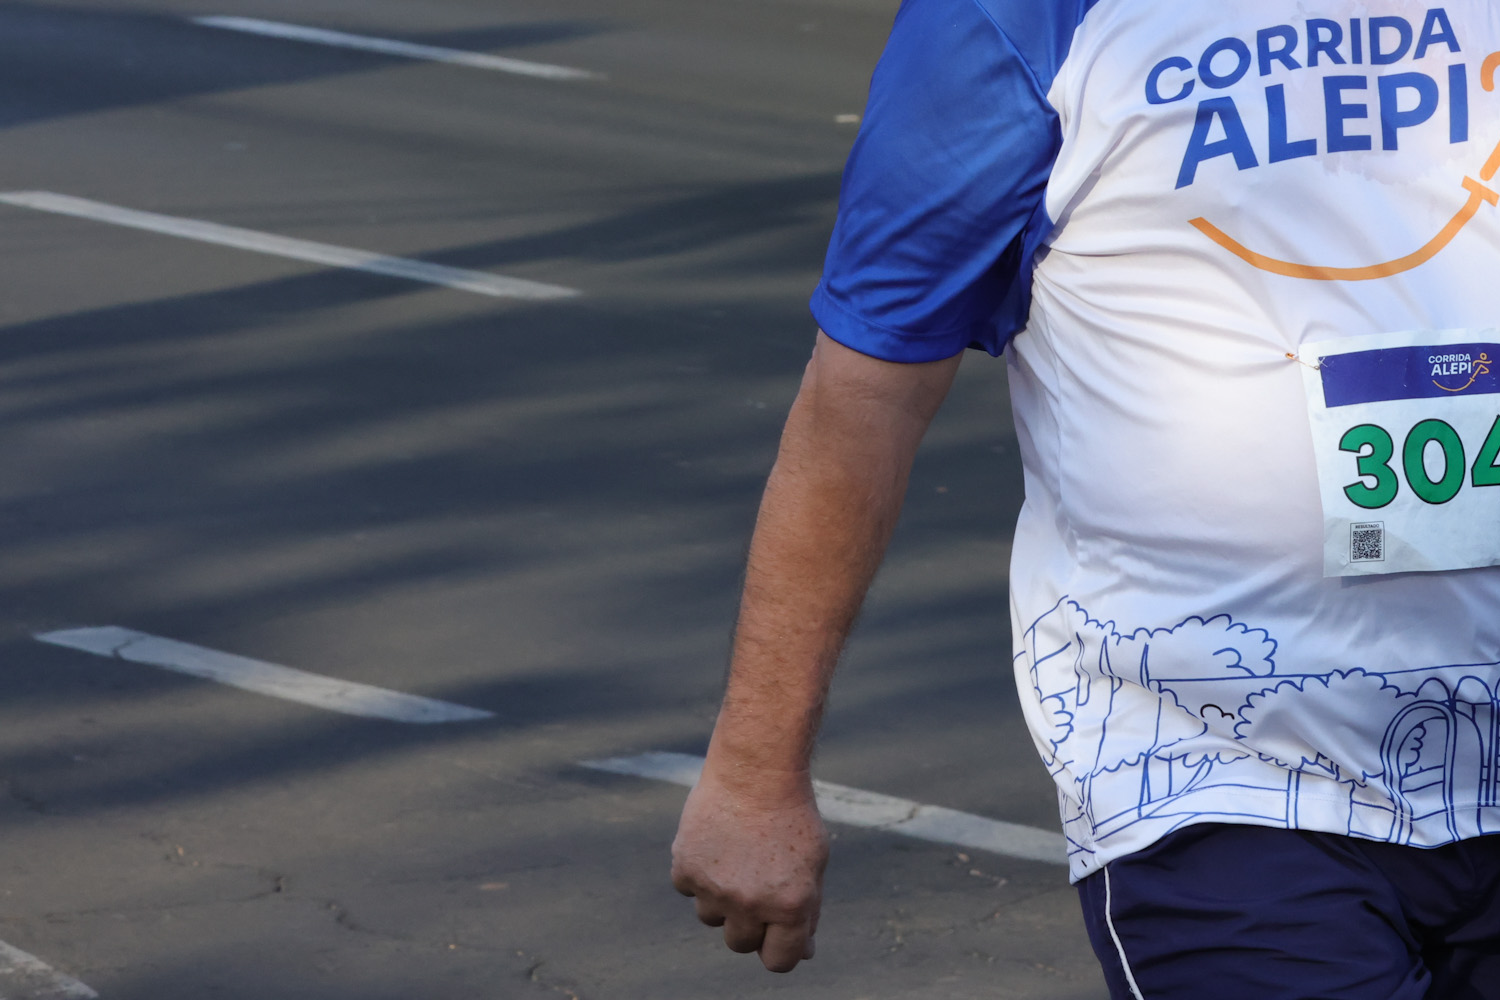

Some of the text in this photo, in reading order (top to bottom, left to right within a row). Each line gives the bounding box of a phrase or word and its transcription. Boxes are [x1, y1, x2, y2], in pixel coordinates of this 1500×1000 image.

[1144, 7, 1462, 105] CORRIDA
[1174, 62, 1469, 190] ALEPI
[1428, 353, 1471, 364] CORRIDA
[1430, 361, 1472, 377] ALEPI
